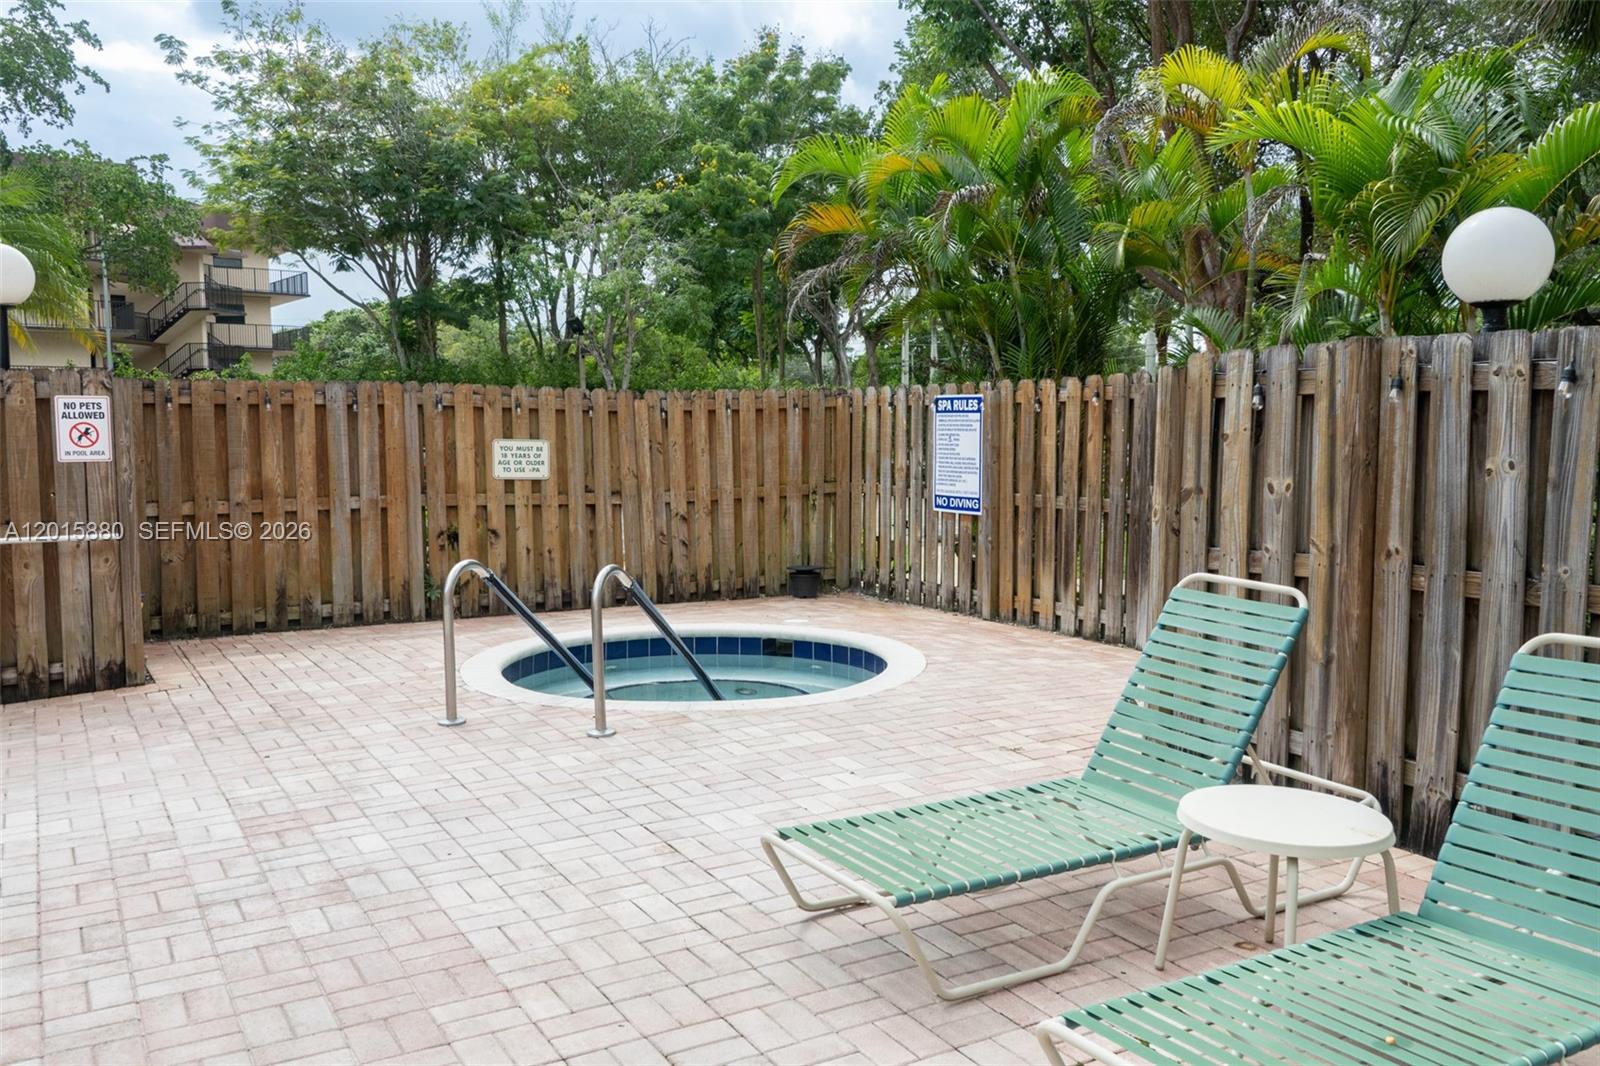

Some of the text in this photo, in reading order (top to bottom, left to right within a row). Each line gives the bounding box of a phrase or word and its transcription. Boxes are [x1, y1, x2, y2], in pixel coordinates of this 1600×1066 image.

[63, 402, 102, 410] NO PETS
[937, 399, 978, 411] SPA RULES
[61, 411, 105, 419] ALLOWED
[936, 496, 979, 509] NO DIVING
